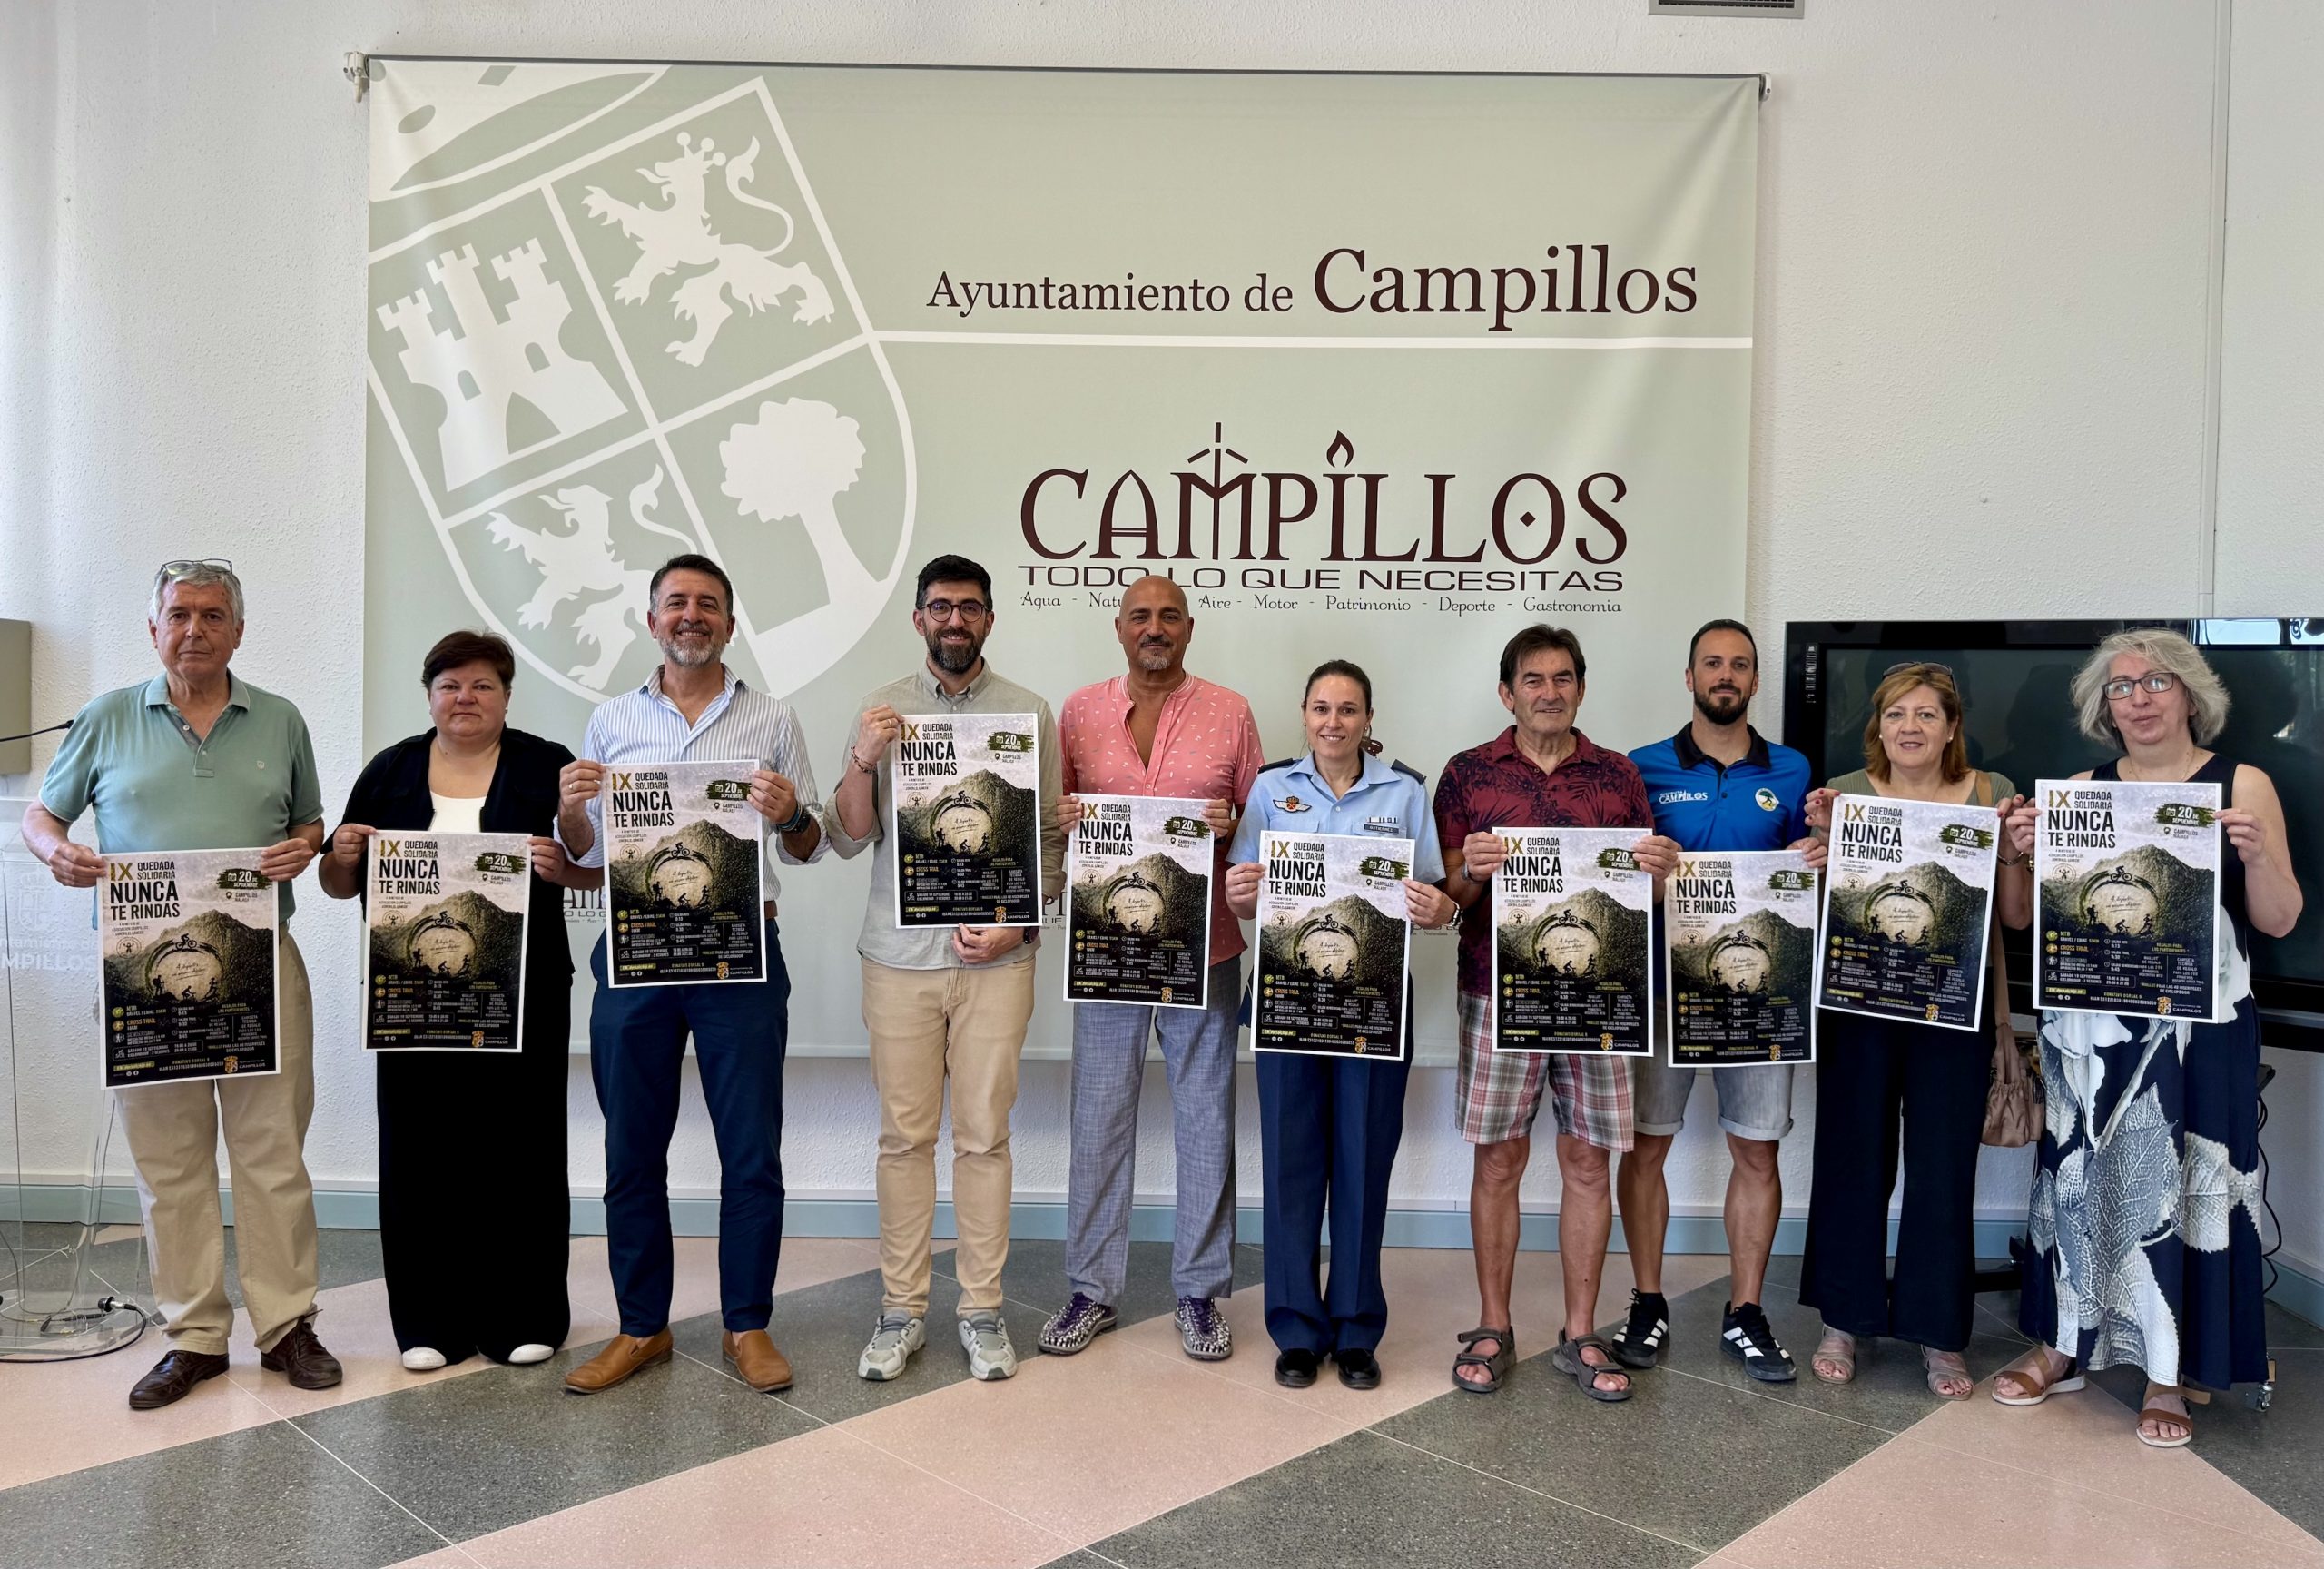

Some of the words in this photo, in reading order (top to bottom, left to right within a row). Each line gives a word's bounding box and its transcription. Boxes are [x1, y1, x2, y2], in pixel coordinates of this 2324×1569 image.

[927, 271, 1230, 318] Ayuntamiento
[1244, 273, 1294, 311] de
[1315, 244, 1698, 331] Campillos
[1020, 427, 1628, 565] CAMPILLOS
[1241, 568, 1341, 590] QUE
[1359, 569, 1623, 592] NECESITAS
[1020, 591, 1061, 611] Agua
[1198, 596, 1231, 610] Aire
[1254, 594, 1298, 610] Motor
[1325, 595, 1411, 613] Patrimonio
[1439, 596, 1496, 617] Deporte
[1523, 596, 1622, 613] Gastronomia
[901, 724, 920, 741] IX
[922, 723, 953, 732] QUEDADA
[922, 732, 953, 740] SOLIDARIA
[1005, 735, 1017, 745] 20
[901, 741, 956, 761] NUNCA
[901, 763, 915, 776] TE
[918, 762, 958, 776] RINDAS
[612, 773, 633, 791] IX
[635, 772, 668, 781] QUEDADA
[635, 781, 669, 790] SOLIDARIA
[724, 783, 737, 794] 20
[613, 791, 673, 813] NUNCA
[2048, 790, 2071, 809] IX
[2074, 791, 2112, 801] QUEDADA
[2074, 801, 2112, 810] SOLIDARIA
[1101, 804, 1131, 814] QUEDADA
[1844, 804, 1866, 823] IX
[1868, 806, 1903, 818] QUEDADA
[2178, 807, 2192, 819] 20
[614, 814, 628, 828] TE
[631, 813, 675, 827] RINDAS
[1100, 813, 1131, 822] SOLIDARIA
[1181, 820, 1193, 830] 20
[1867, 815, 1903, 826] SOLIDARIA
[2048, 810, 2115, 832] NUNCA
[1079, 821, 1133, 842] NUNCA
[1842, 822, 1904, 847] NUNCA
[1960, 828, 1974, 840] 20
[380, 839, 401, 857] IX
[404, 841, 438, 850] QUEDADA
[1527, 838, 1560, 846] QUEDADA
[2048, 832, 2063, 847] TE
[2067, 833, 2116, 849] RINDAS
[404, 850, 438, 858] SOLIDARIA
[1078, 841, 1091, 854] TE
[1095, 842, 1134, 856] RINDAS
[1270, 840, 1290, 859] IX
[1293, 842, 1325, 853] QUEDADA
[1292, 851, 1324, 861] SOLIDARIA
[1527, 847, 1560, 855] SOLIDARIA
[1840, 844, 1856, 858] TE
[1858, 845, 1903, 863] RINDAS
[494, 855, 507, 866] 20
[1616, 852, 1629, 863] 20
[1699, 860, 1732, 869] QUEDADA
[110, 862, 133, 882] IX
[137, 861, 175, 871] QUEDADA
[379, 859, 440, 879] NUNCA
[1269, 859, 1327, 883] NUNCA
[1378, 860, 1391, 872] 20
[1504, 856, 1562, 877] NUNCA
[1699, 869, 1732, 877] SOLIDARIA
[137, 871, 175, 881] SOLIDARIA
[238, 871, 251, 883] 20
[1786, 873, 1798, 883] 20
[110, 880, 179, 904] NUNCA
[379, 880, 393, 894] TE
[397, 881, 441, 895] RINDAS
[1268, 881, 1282, 895] TE
[1285, 882, 1327, 898] RINDAS
[1503, 878, 1517, 893] TE
[1521, 878, 1563, 893] RINDAS
[1677, 879, 1735, 899] NUNCA
[111, 905, 127, 921] TE
[131, 903, 181, 920] RINDAS
[1677, 901, 1690, 914] TE
[1694, 900, 1736, 914] RINDAS
